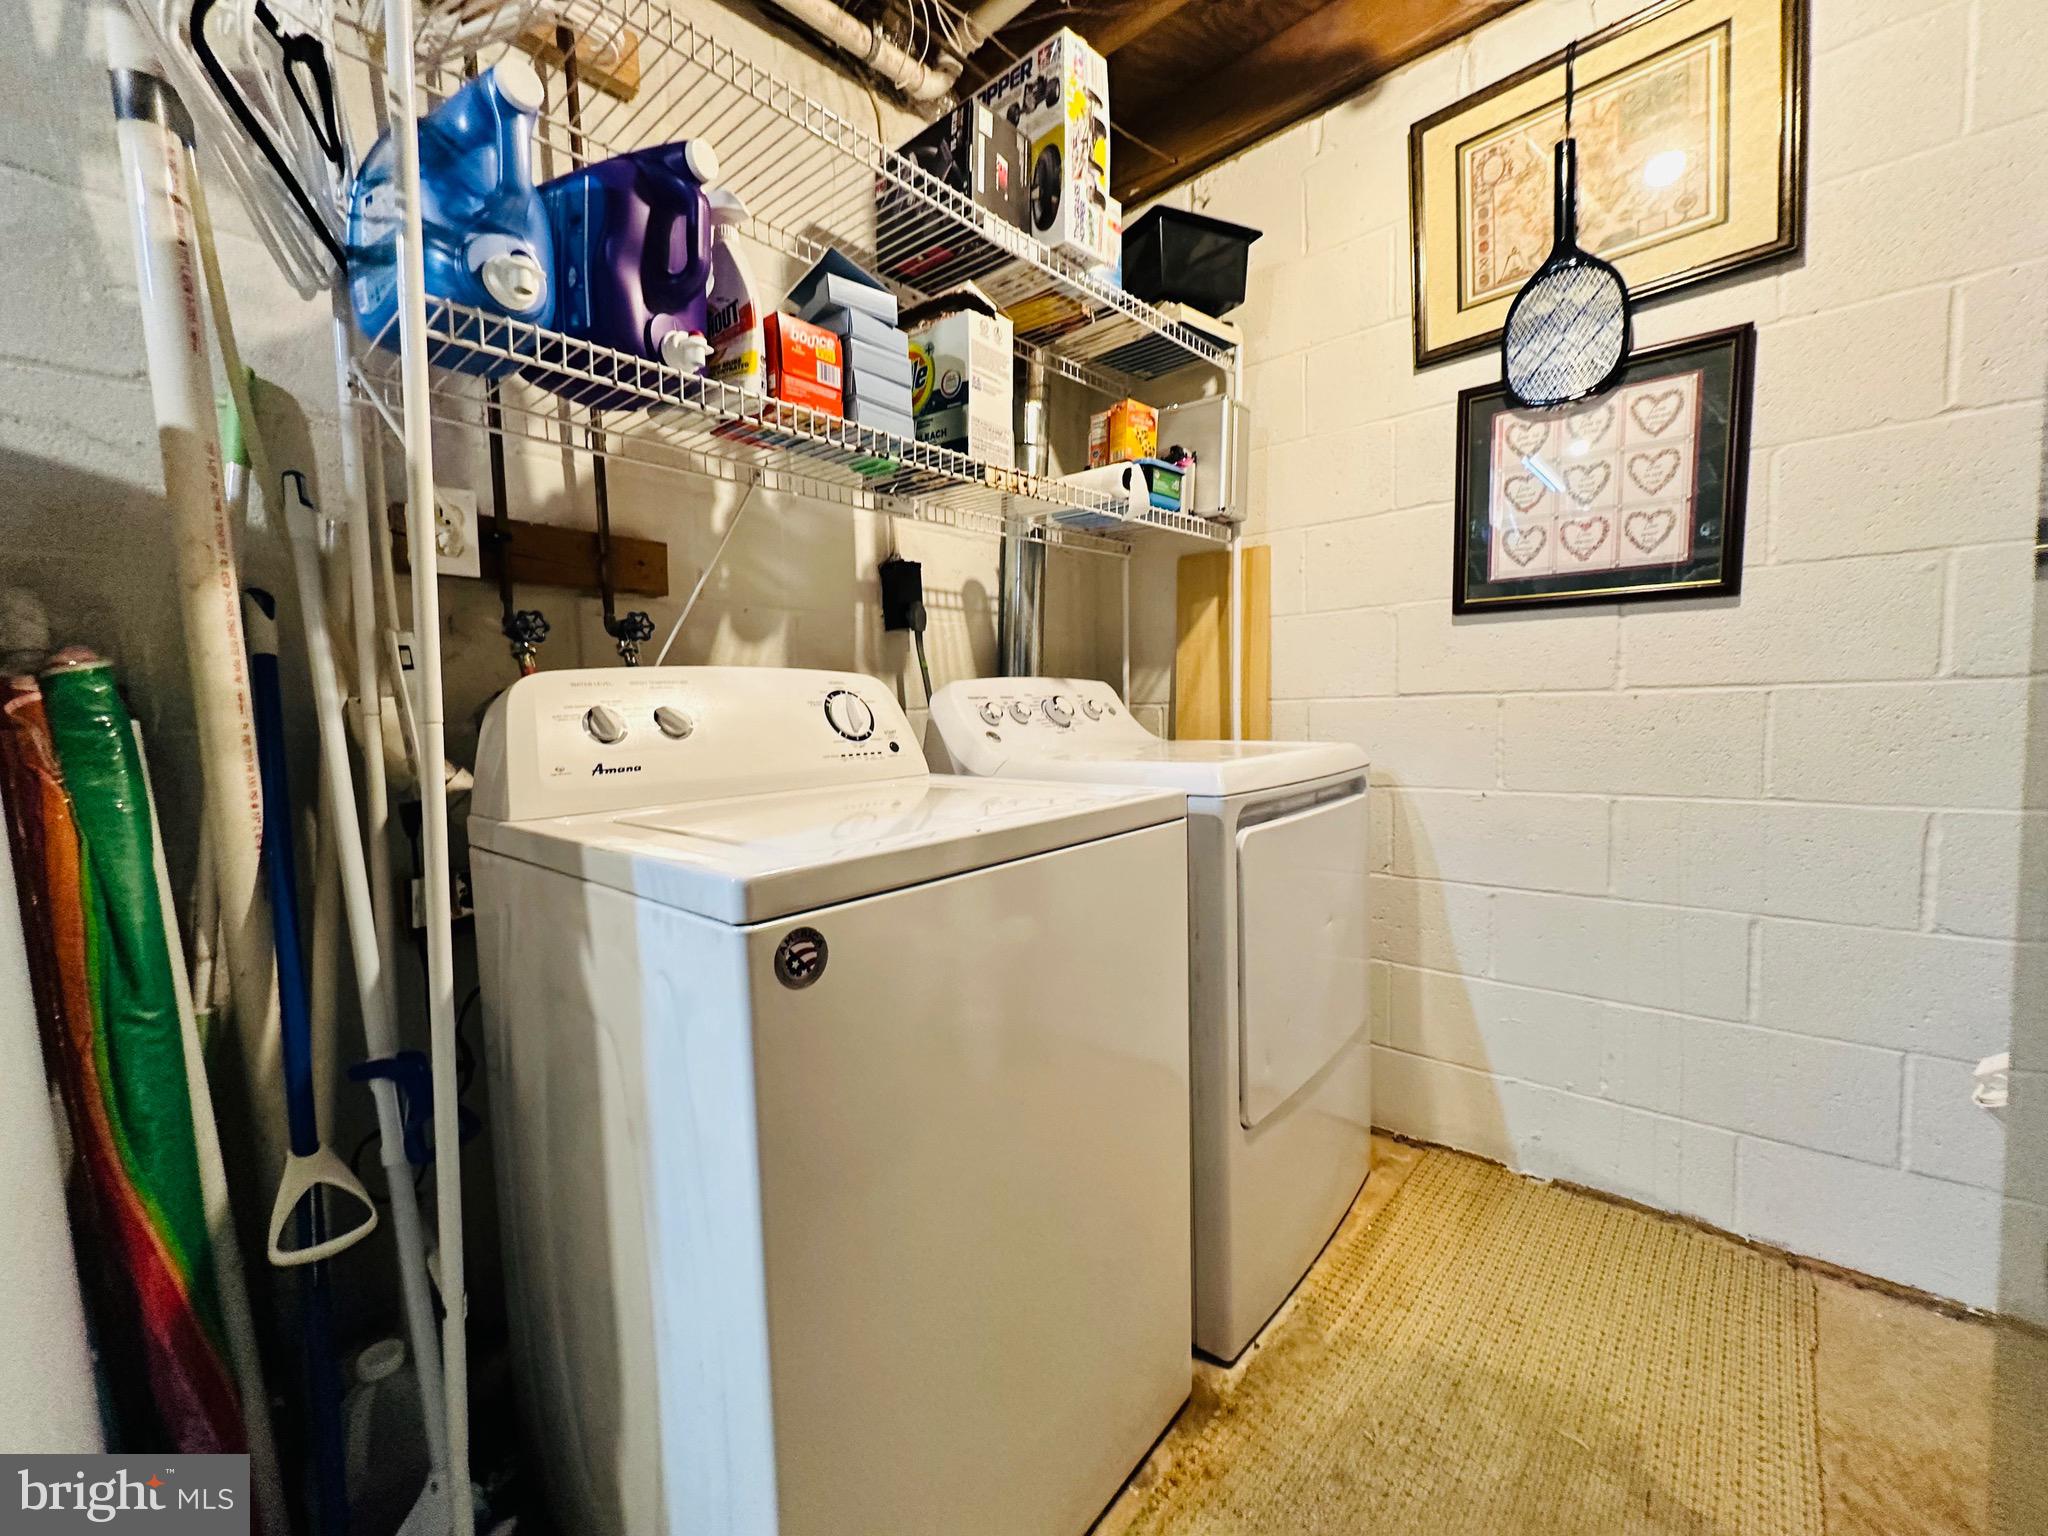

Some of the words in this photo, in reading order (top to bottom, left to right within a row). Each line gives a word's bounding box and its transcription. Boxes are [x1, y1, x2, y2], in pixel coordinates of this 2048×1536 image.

[977, 56, 1033, 108] PPER
[708, 298, 739, 339] HOUT
[791, 328, 836, 349] bounce
[592, 762, 642, 776] Amana
